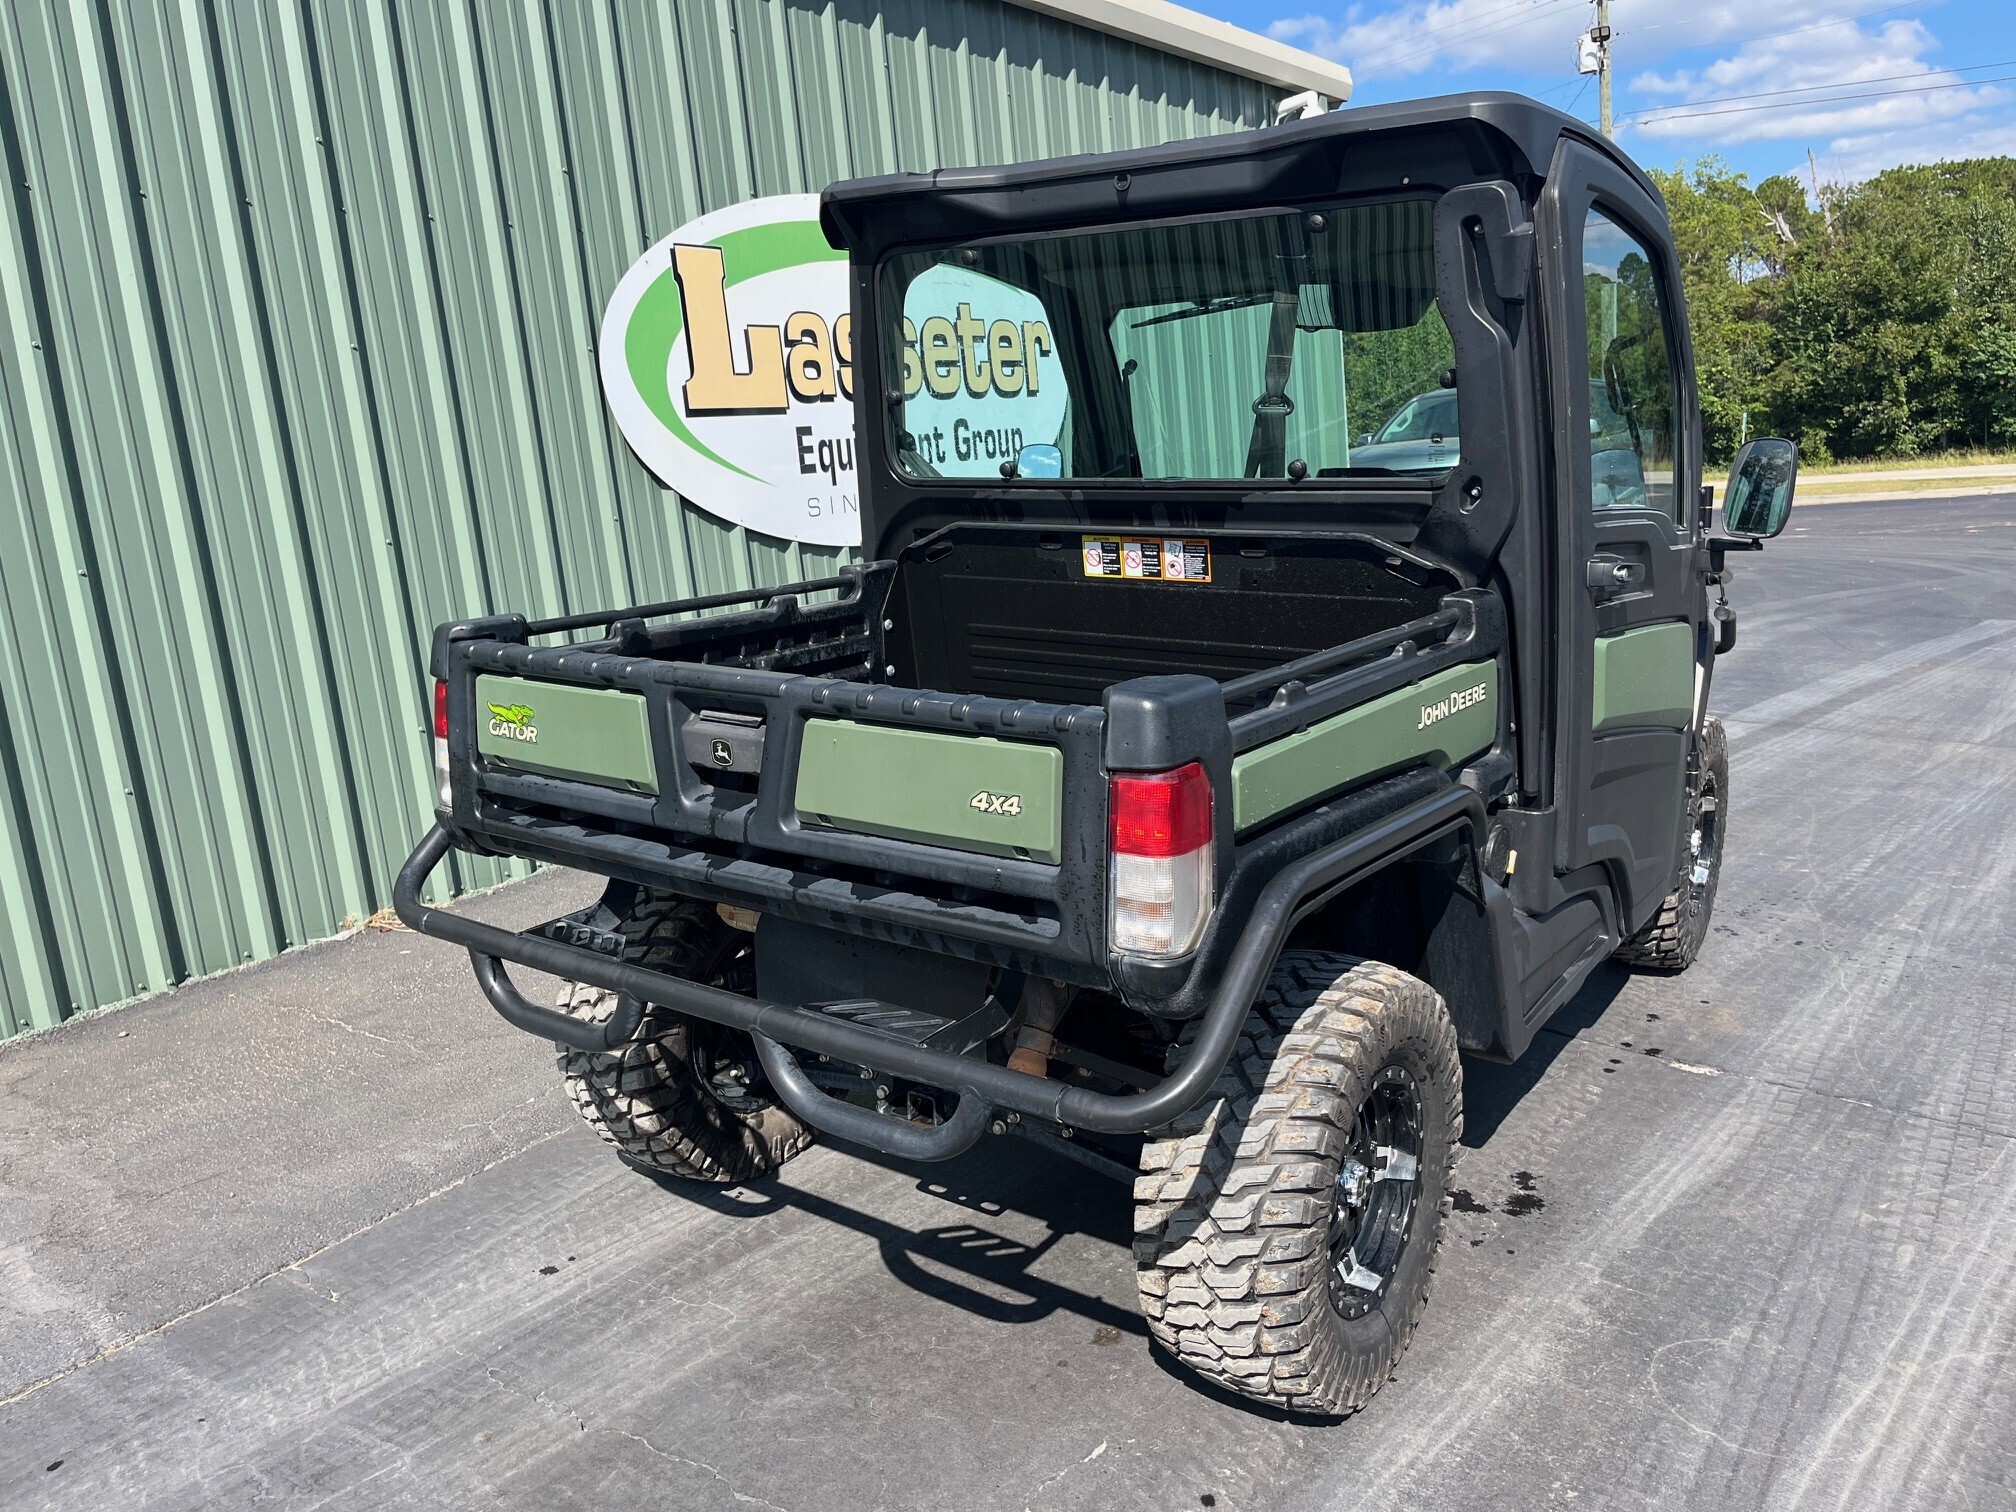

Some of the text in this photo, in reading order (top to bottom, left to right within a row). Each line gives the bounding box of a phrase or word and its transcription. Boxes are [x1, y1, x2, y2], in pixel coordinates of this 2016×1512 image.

[795, 418, 1024, 487] Equnt Group
[488, 717, 538, 744] GATOR
[1417, 681, 1487, 731] JOHN DEERE
